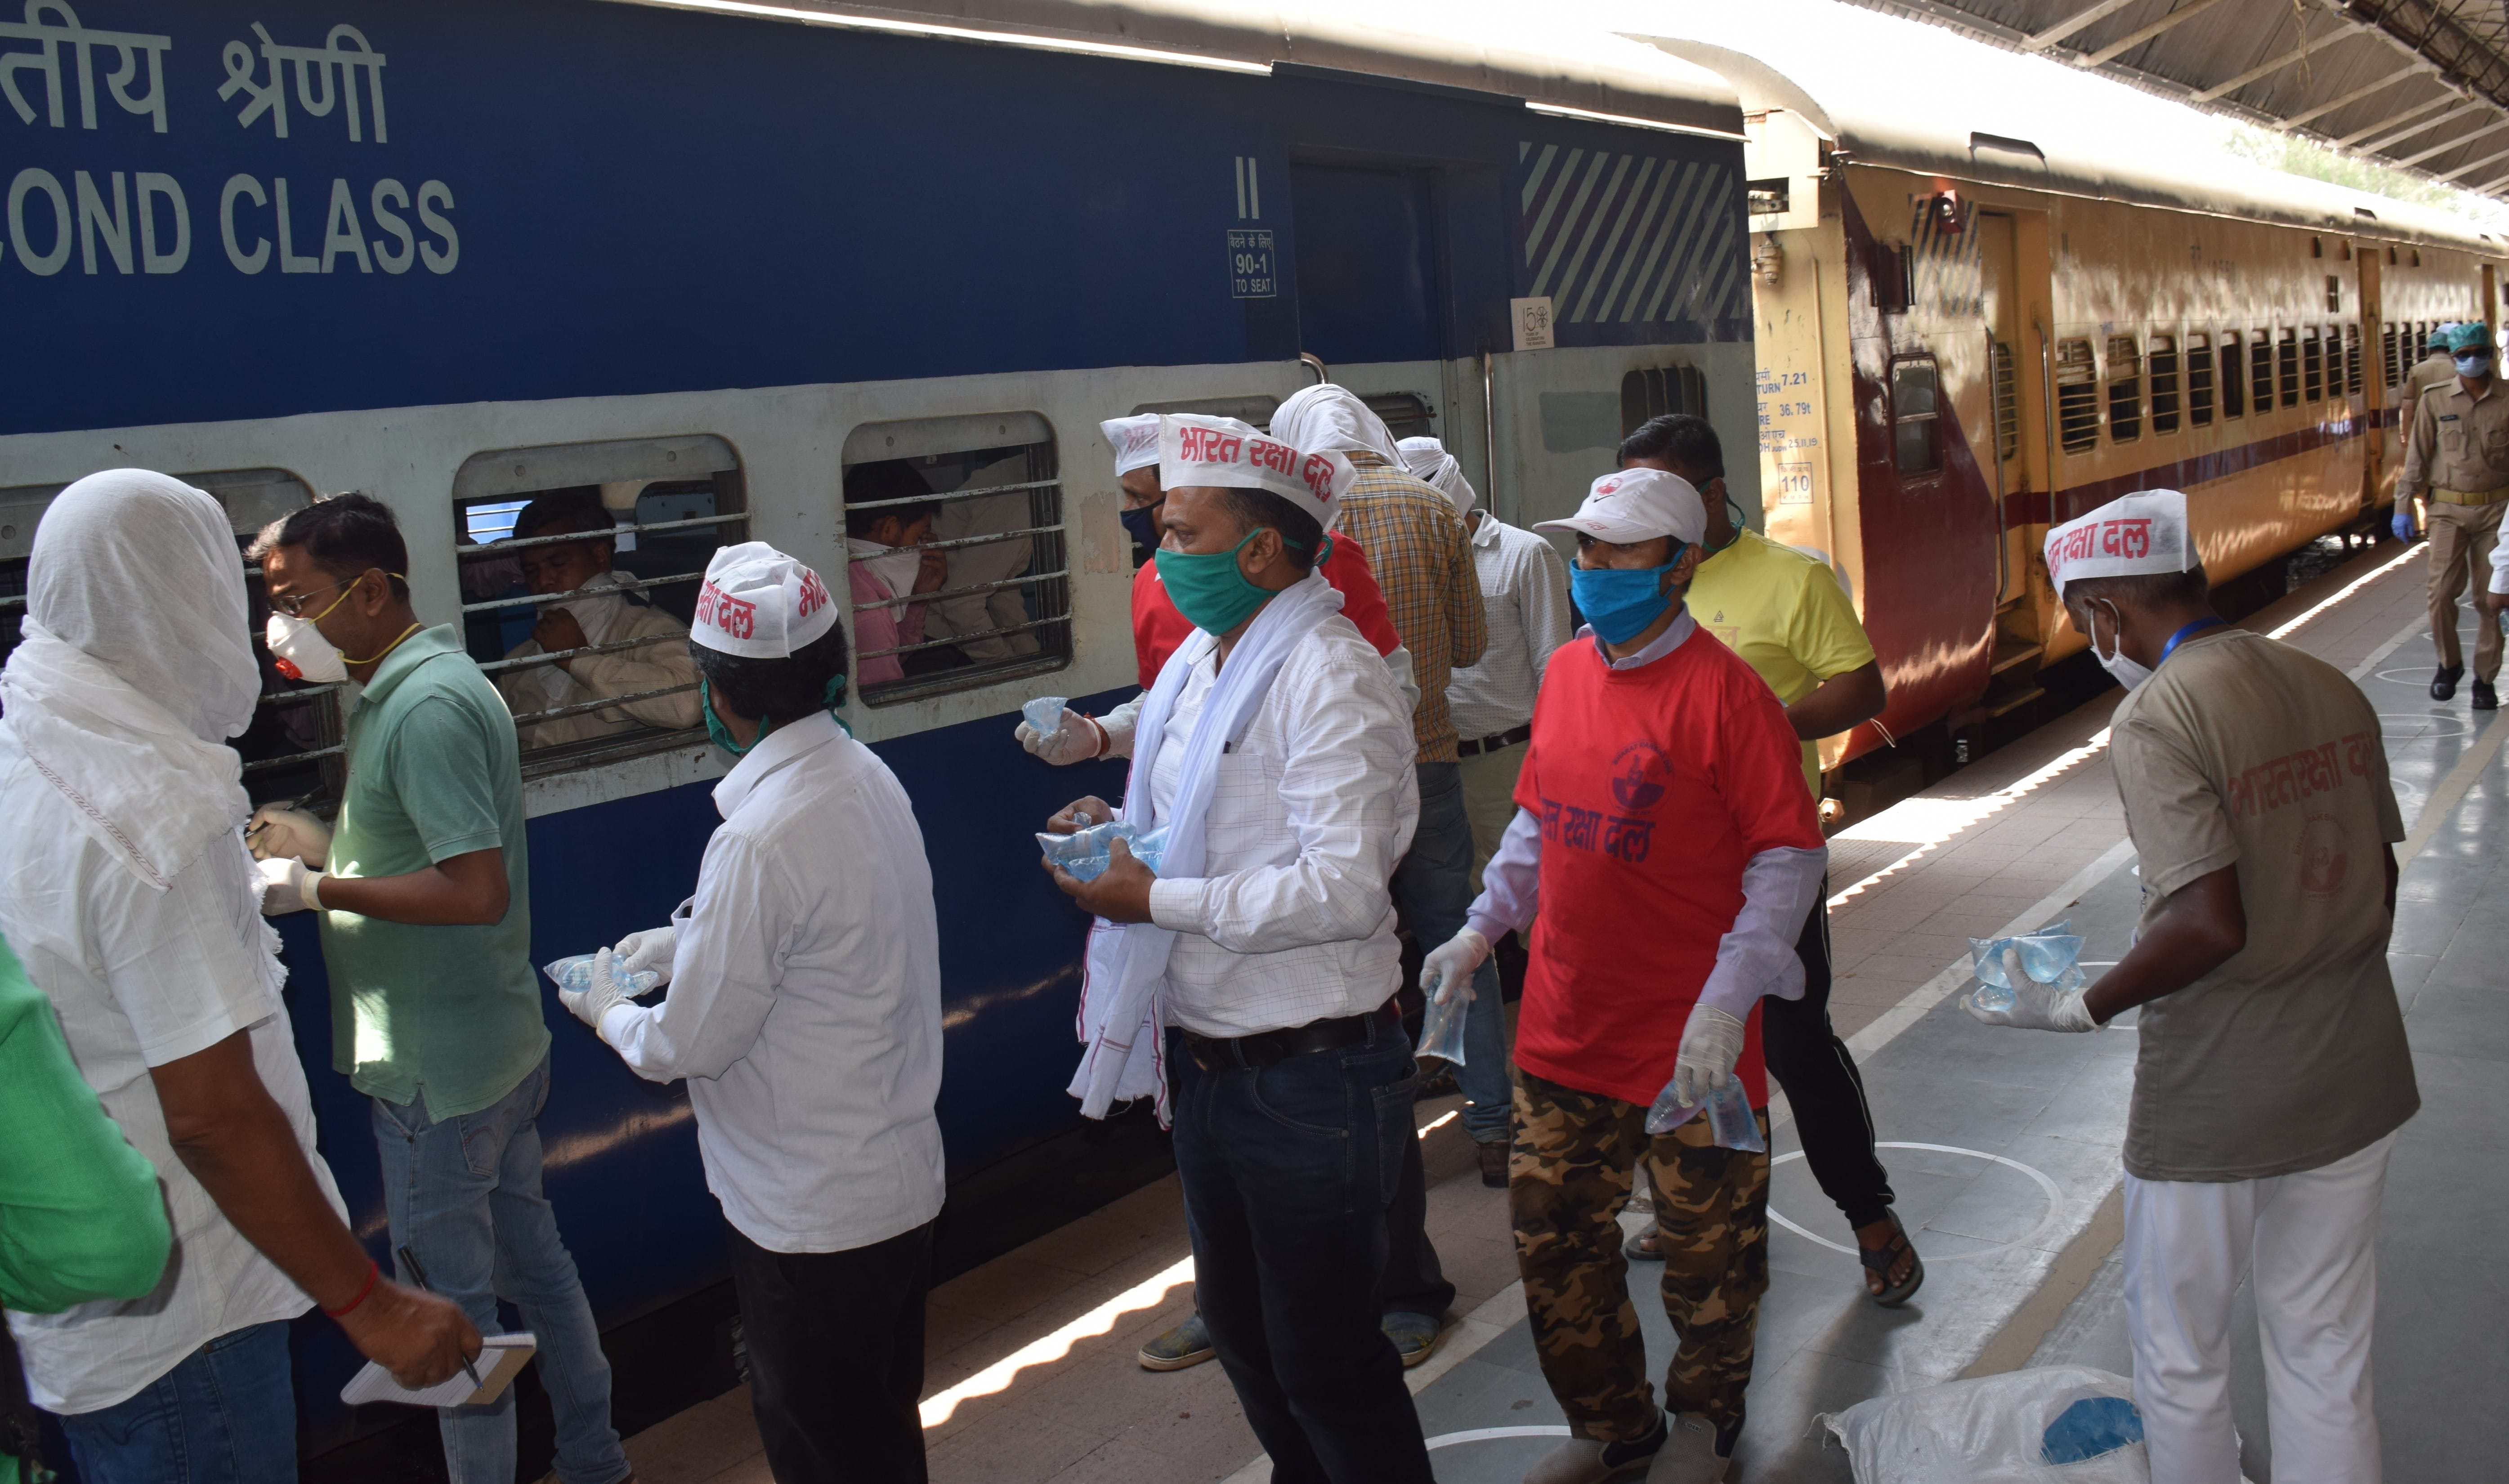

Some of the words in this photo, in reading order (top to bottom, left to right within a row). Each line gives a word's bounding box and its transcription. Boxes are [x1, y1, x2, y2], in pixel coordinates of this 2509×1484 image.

[217, 21, 388, 143] श्रेणी
[0, 168, 191, 276] OND
[220, 174, 459, 274] CLASS
[1230, 233, 1245, 248] बैठने
[1248, 233, 1255, 248] के
[1258, 233, 1271, 250] लिए
[1236, 253, 1266, 274] 90-1
[1236, 279, 1247, 292] TO
[1251, 278, 1270, 292] SEAT
[1781, 372, 1807, 386] 7.21
[1180, 427, 1244, 463] भारत
[1249, 438, 1297, 477] रक्षा
[1782, 475, 1809, 492] 110
[2063, 523, 2098, 563] रक्षा
[2102, 519, 2151, 559] दल
[718, 592, 756, 639] दल
[2228, 755, 2299, 819] भारत
[2290, 741, 2344, 799] रक्षा
[1564, 806, 1603, 852] रक्षा
[1604, 815, 1656, 863] दल
